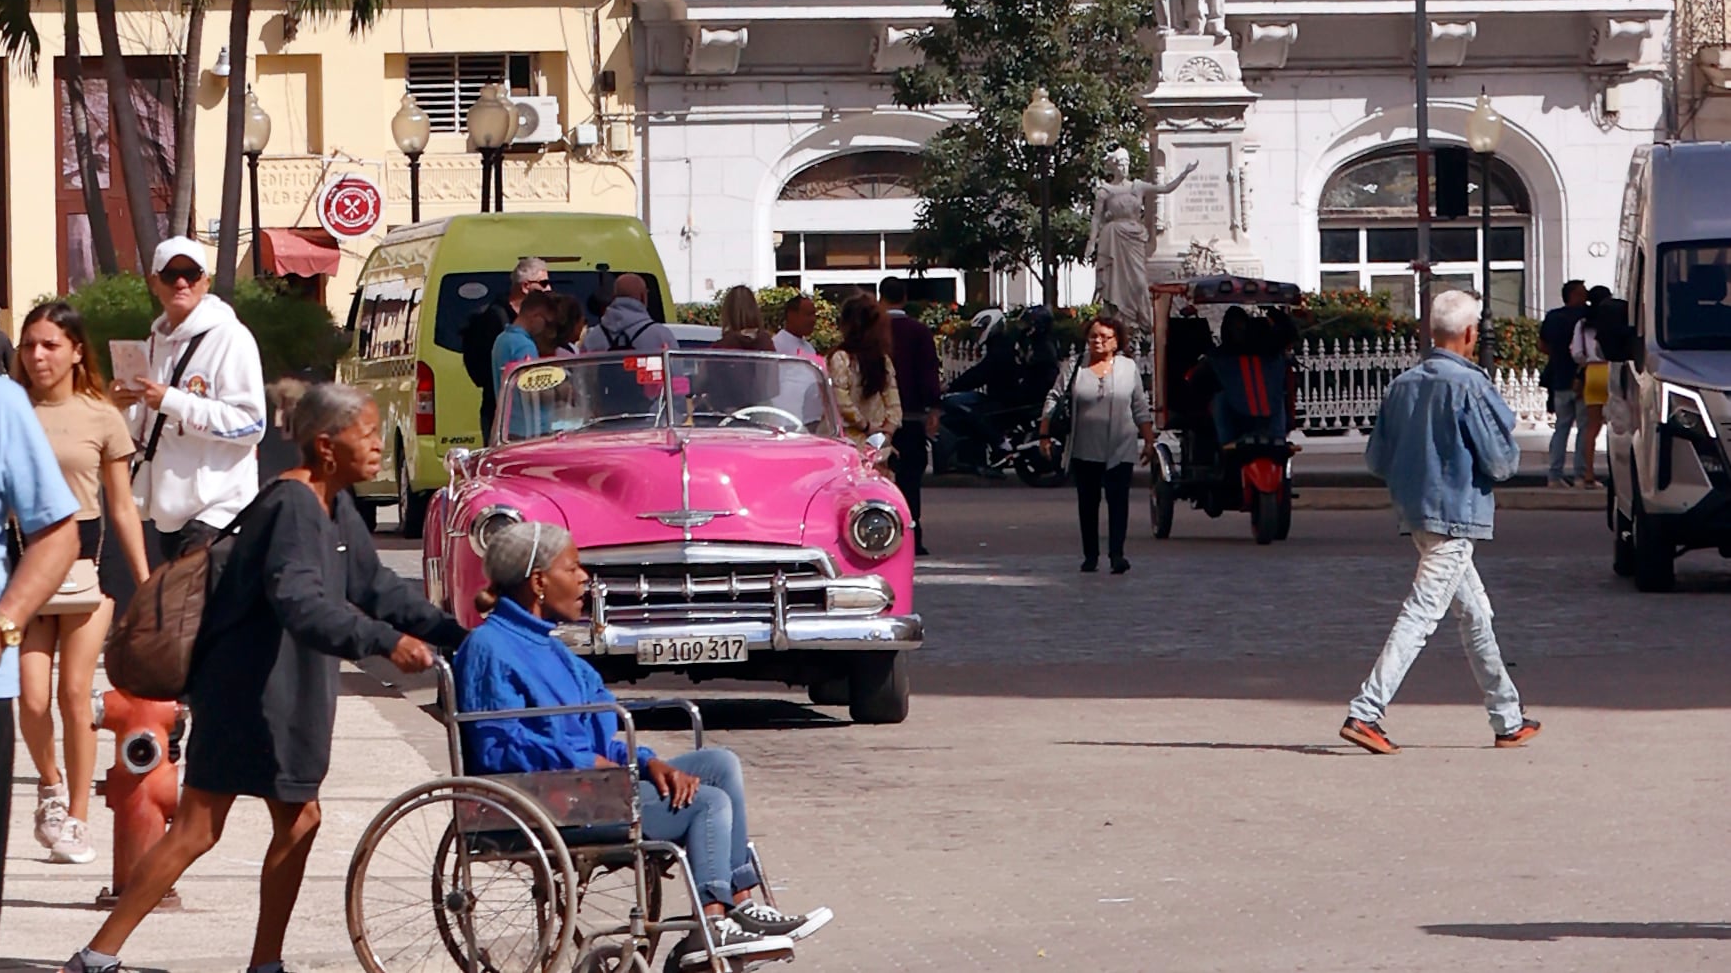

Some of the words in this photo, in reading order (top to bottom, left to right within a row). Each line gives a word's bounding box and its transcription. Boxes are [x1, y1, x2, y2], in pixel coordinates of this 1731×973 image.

[653, 643, 664, 663] P
[668, 641, 704, 661] 109
[708, 639, 743, 660] 317
